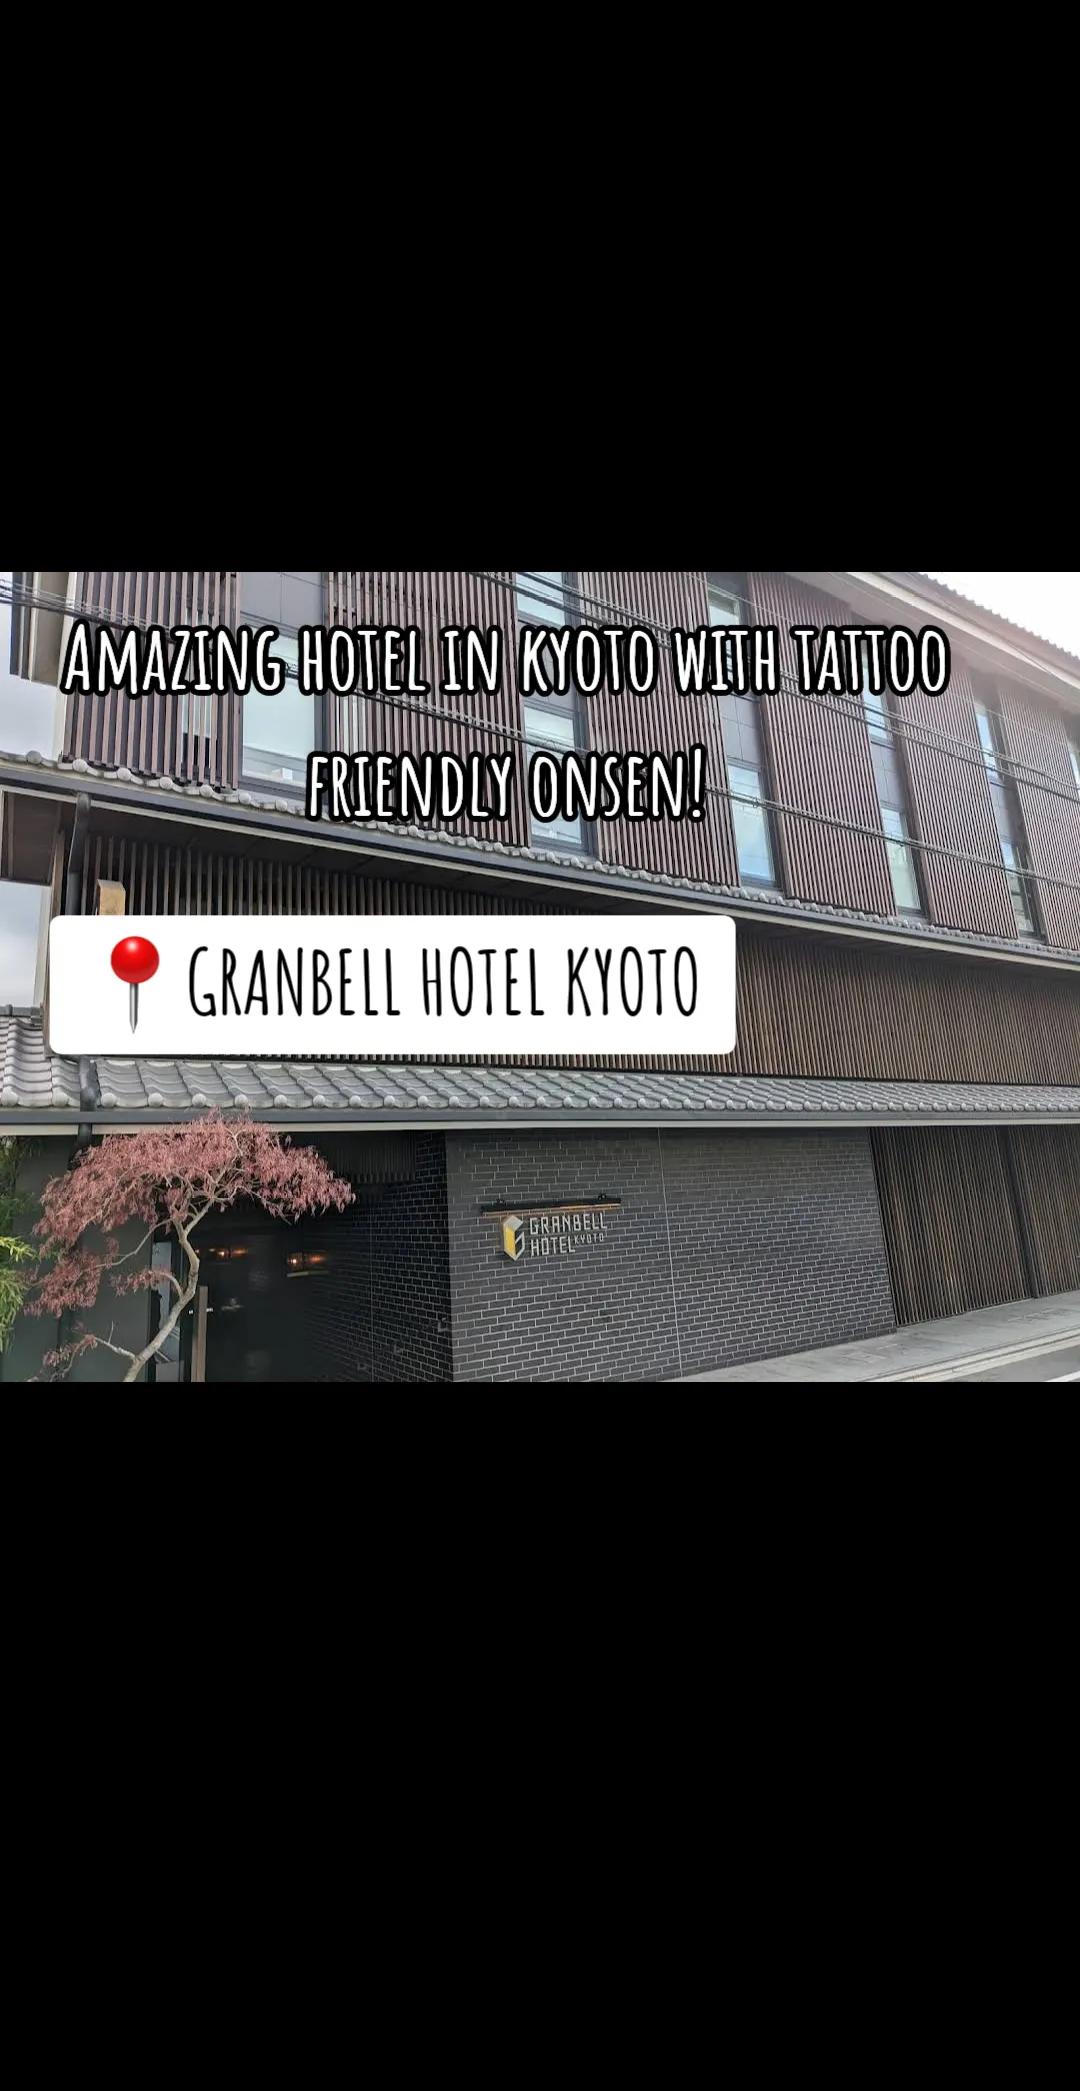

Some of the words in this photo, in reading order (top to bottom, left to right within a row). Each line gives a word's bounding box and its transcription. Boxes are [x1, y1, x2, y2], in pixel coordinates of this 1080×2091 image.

[529, 1212, 608, 1235] GRANBELL
[530, 1236, 576, 1257] HOTEL
[574, 1232, 604, 1245] KYOTO
